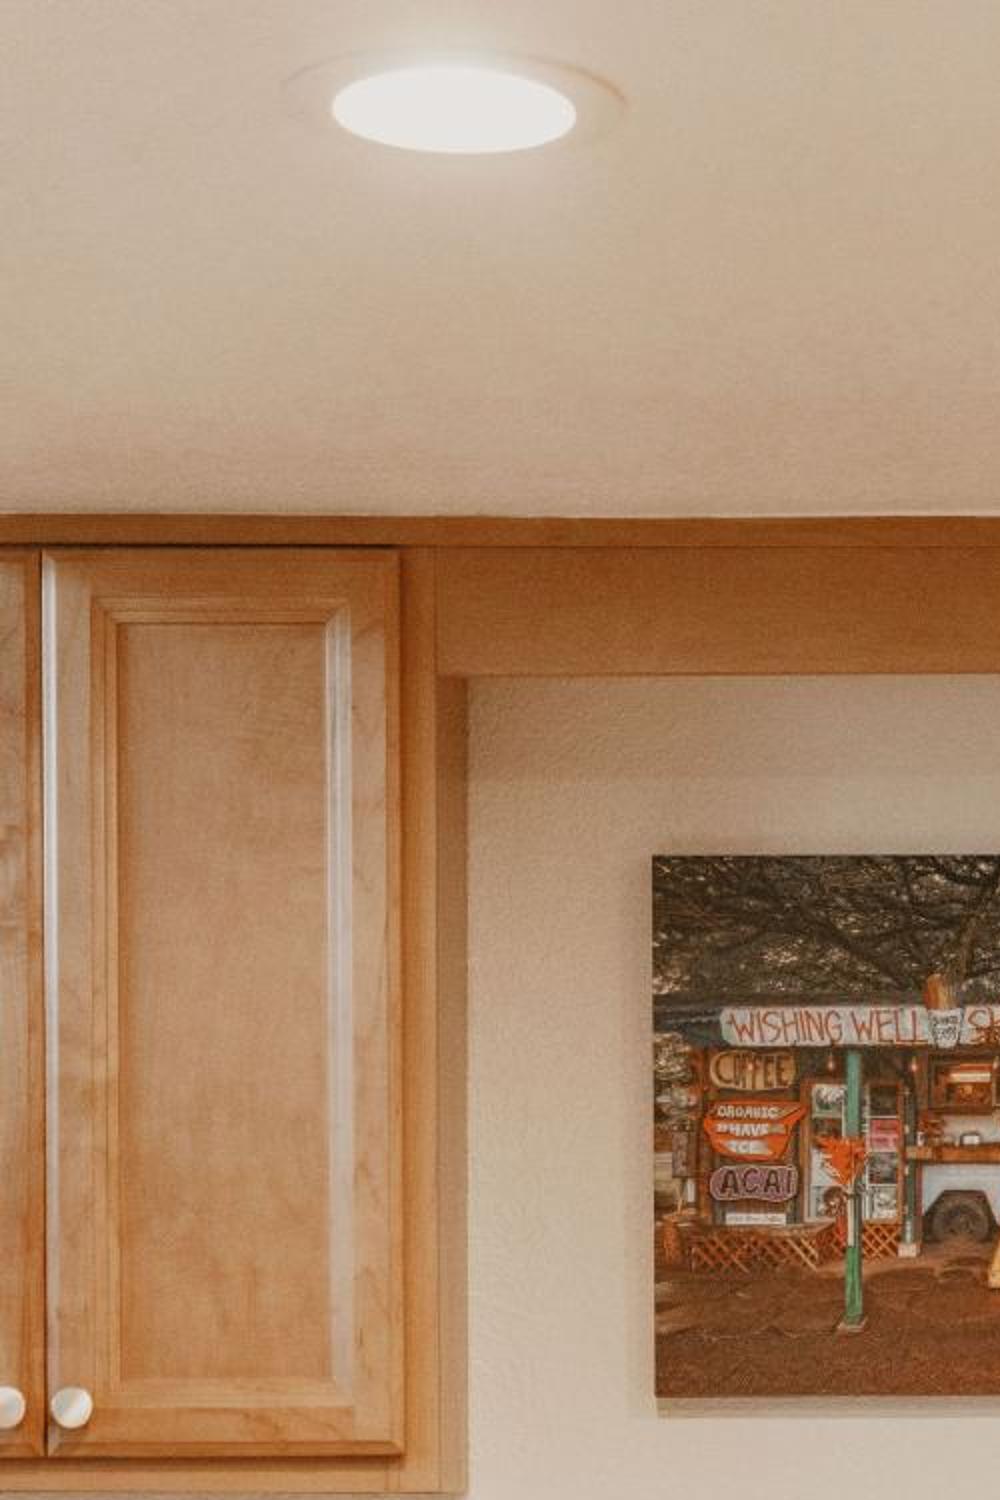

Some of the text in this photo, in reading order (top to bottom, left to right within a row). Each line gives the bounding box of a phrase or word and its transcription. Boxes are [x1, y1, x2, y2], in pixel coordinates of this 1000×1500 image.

[727, 1009, 842, 1043] WISHING
[850, 1008, 926, 1045] WELL
[720, 1169, 792, 1194] ACAI
